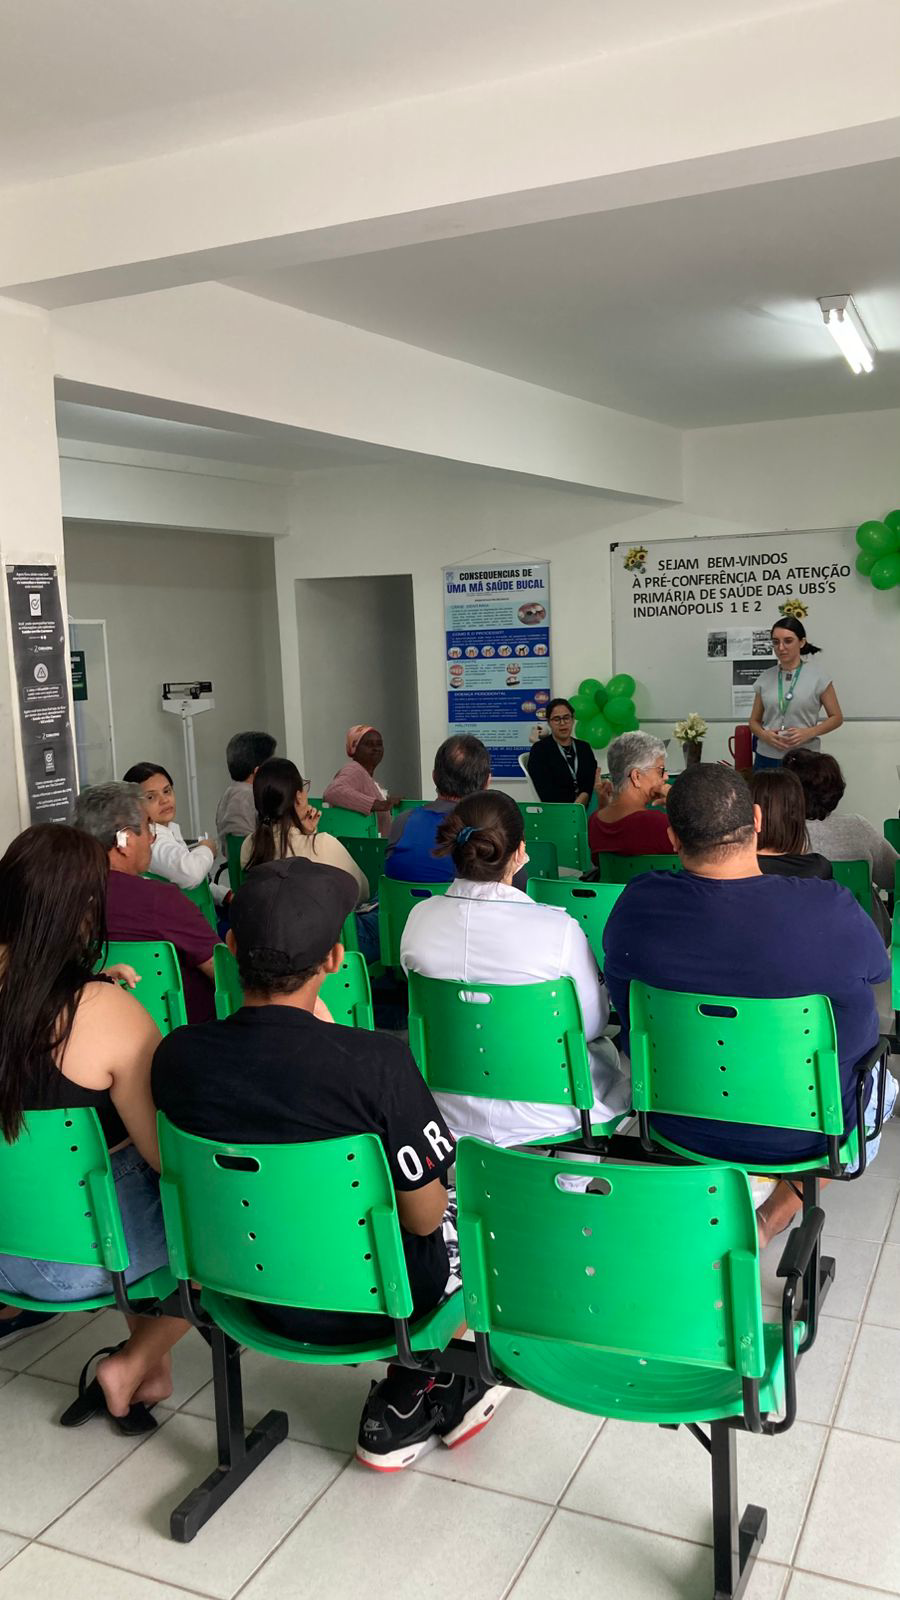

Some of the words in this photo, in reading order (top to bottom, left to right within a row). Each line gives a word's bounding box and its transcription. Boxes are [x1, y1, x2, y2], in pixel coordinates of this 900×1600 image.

[658, 558, 699, 571] SEJAM
[707, 552, 788, 569] BEM-VINDOS
[459, 569, 520, 581] CONSEQUENCIAS
[522, 568, 533, 577] DE
[632, 574, 641, 589] À
[644, 569, 757, 588] PRÉ-CONFERÊNCIA
[762, 569, 781, 581] DA
[786, 563, 851, 580] ATENÇÃO
[447, 583, 467, 594] UMA
[469, 580, 484, 593] MÁ
[486, 579, 514, 591] SAÚDE
[516, 579, 545, 590] BUCAL
[633, 588, 696, 604] PRIMÁRIA
[700, 588, 717, 600] DE
[719, 583, 763, 599] SAÚDE
[767, 583, 793, 596] DAS
[633, 601, 724, 618] INDIANÓPOLIS
[730, 602, 738, 613] 1
[742, 601, 750, 613] E
[754, 600, 762, 612] 2
